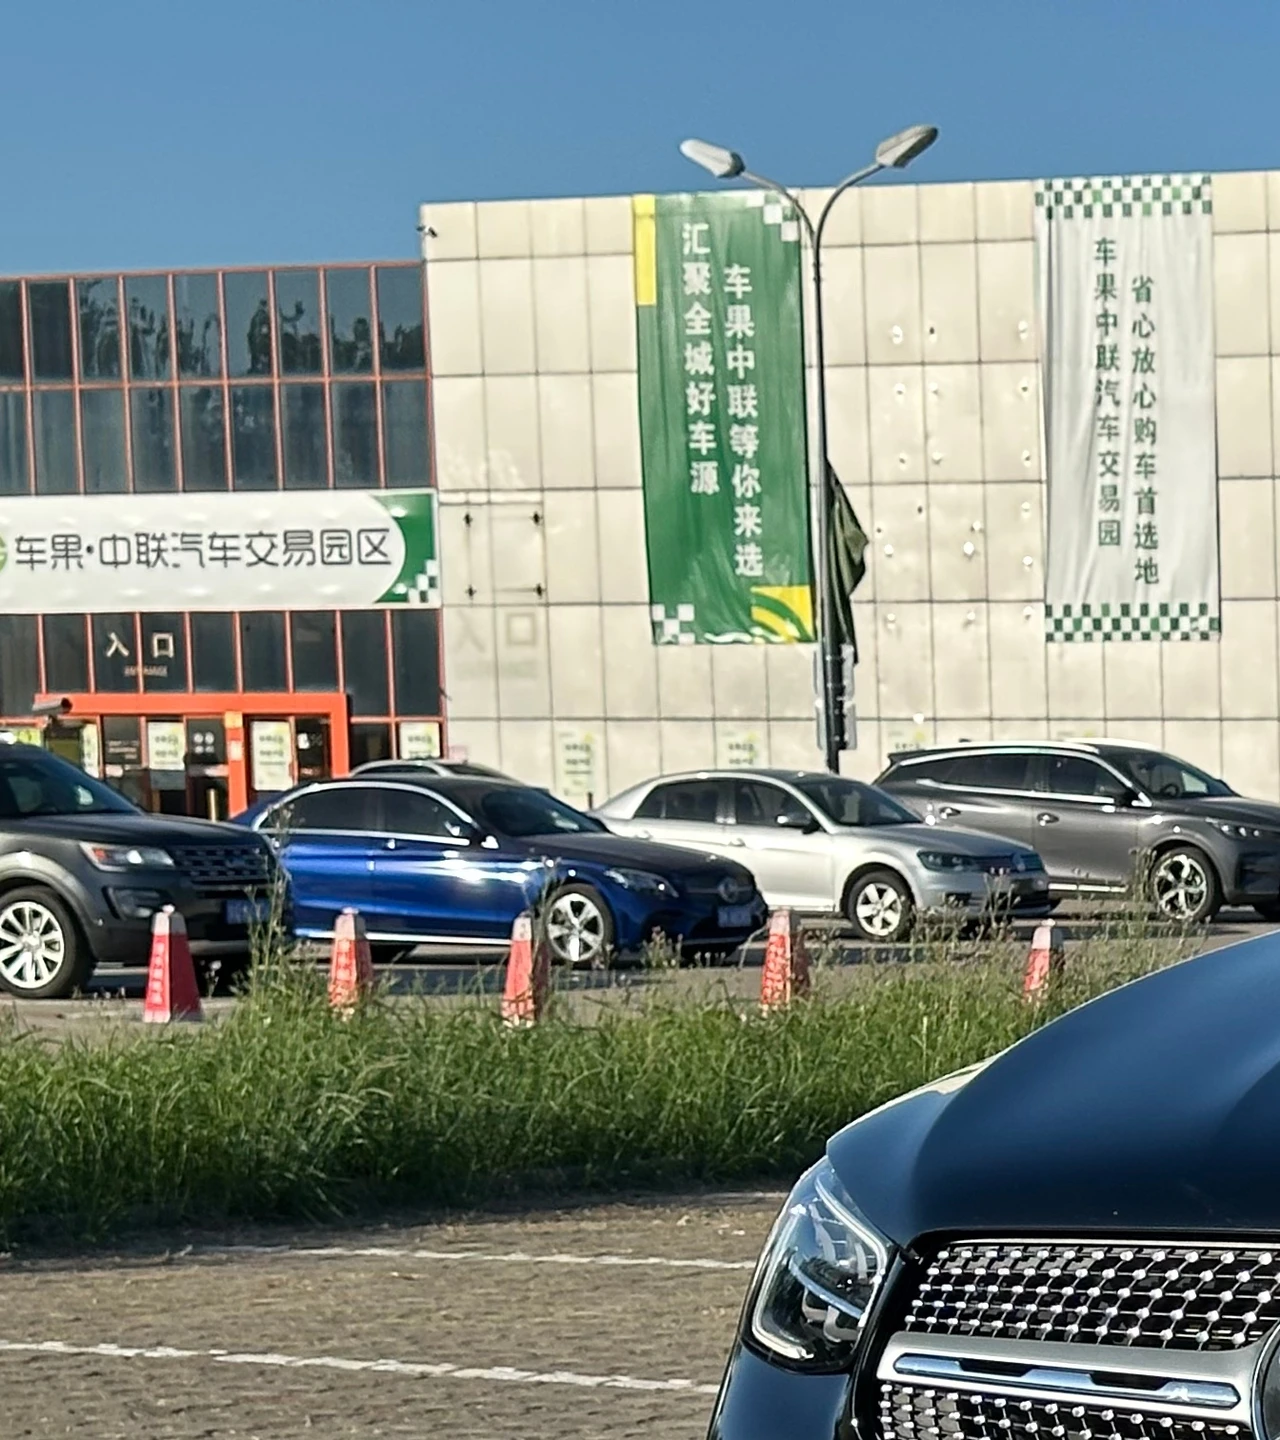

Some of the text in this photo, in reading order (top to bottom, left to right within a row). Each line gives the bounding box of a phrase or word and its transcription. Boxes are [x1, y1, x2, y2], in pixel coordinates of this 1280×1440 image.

[682, 222, 721, 495] 汇聚全城好车源
[723, 263, 764, 578] 车果中联等你来选
[1093, 237, 1122, 547] 车果中联汽车交易园
[1131, 275, 1160, 585] 省心放心购车首选地
[14, 527, 392, 571] 车果·中联汽车交易园区
[106, 632, 174, 658] 入口
